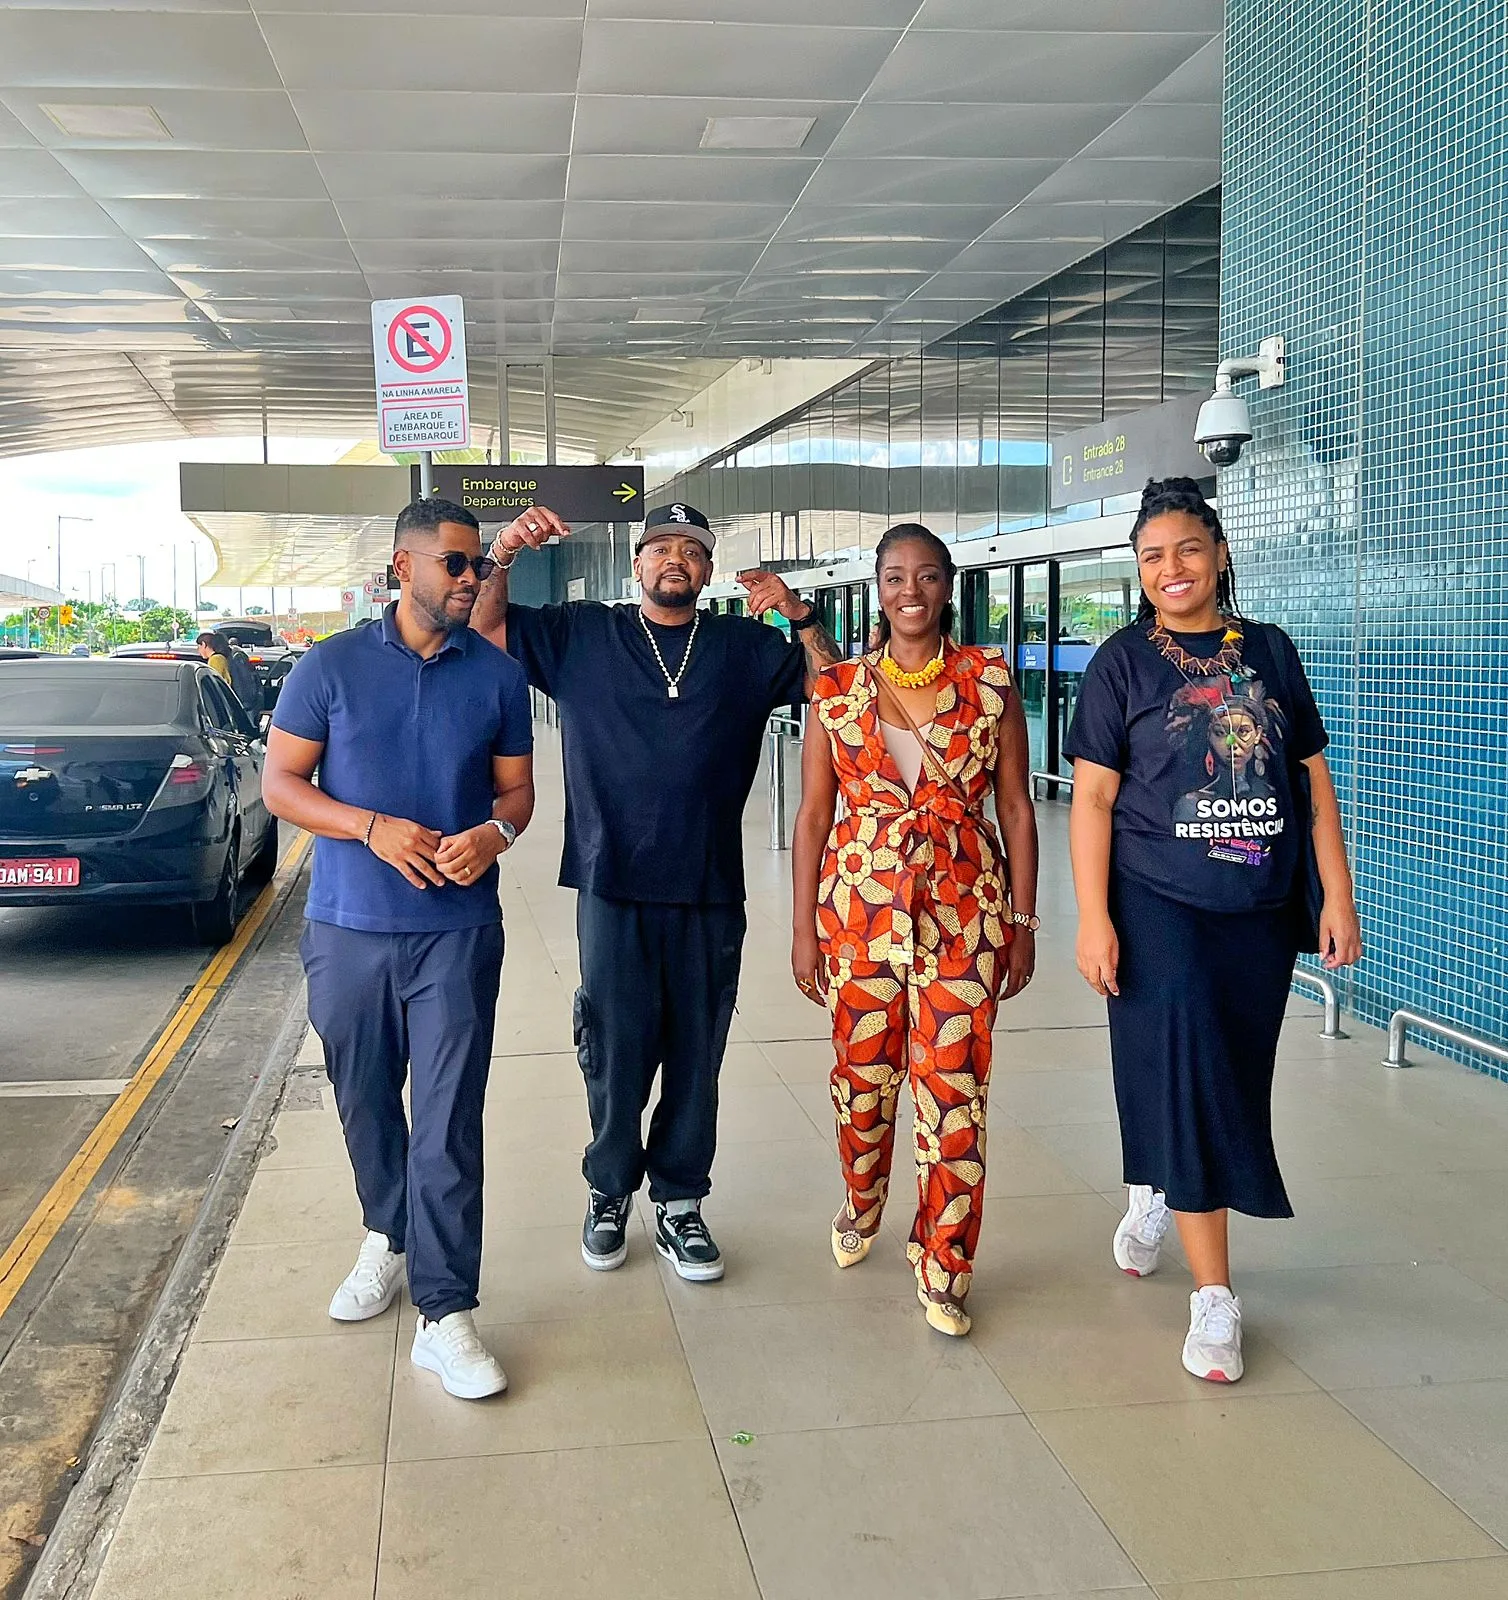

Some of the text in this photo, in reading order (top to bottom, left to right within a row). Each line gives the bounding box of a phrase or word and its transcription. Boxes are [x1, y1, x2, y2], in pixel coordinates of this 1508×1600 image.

[382, 386, 461, 398] NA LINHA AMARELA
[403, 411, 443, 421] ÁREA DE
[393, 422, 445, 431] EMBARQUE
[389, 431, 459, 442] DESEMBARQUE
[1083, 435, 1125, 460] Entrada 28
[1083, 459, 1125, 482] Entrance 28
[462, 478, 537, 493] Embarque
[463, 495, 534, 508] Departures
[1196, 797, 1277, 818] SOMOS
